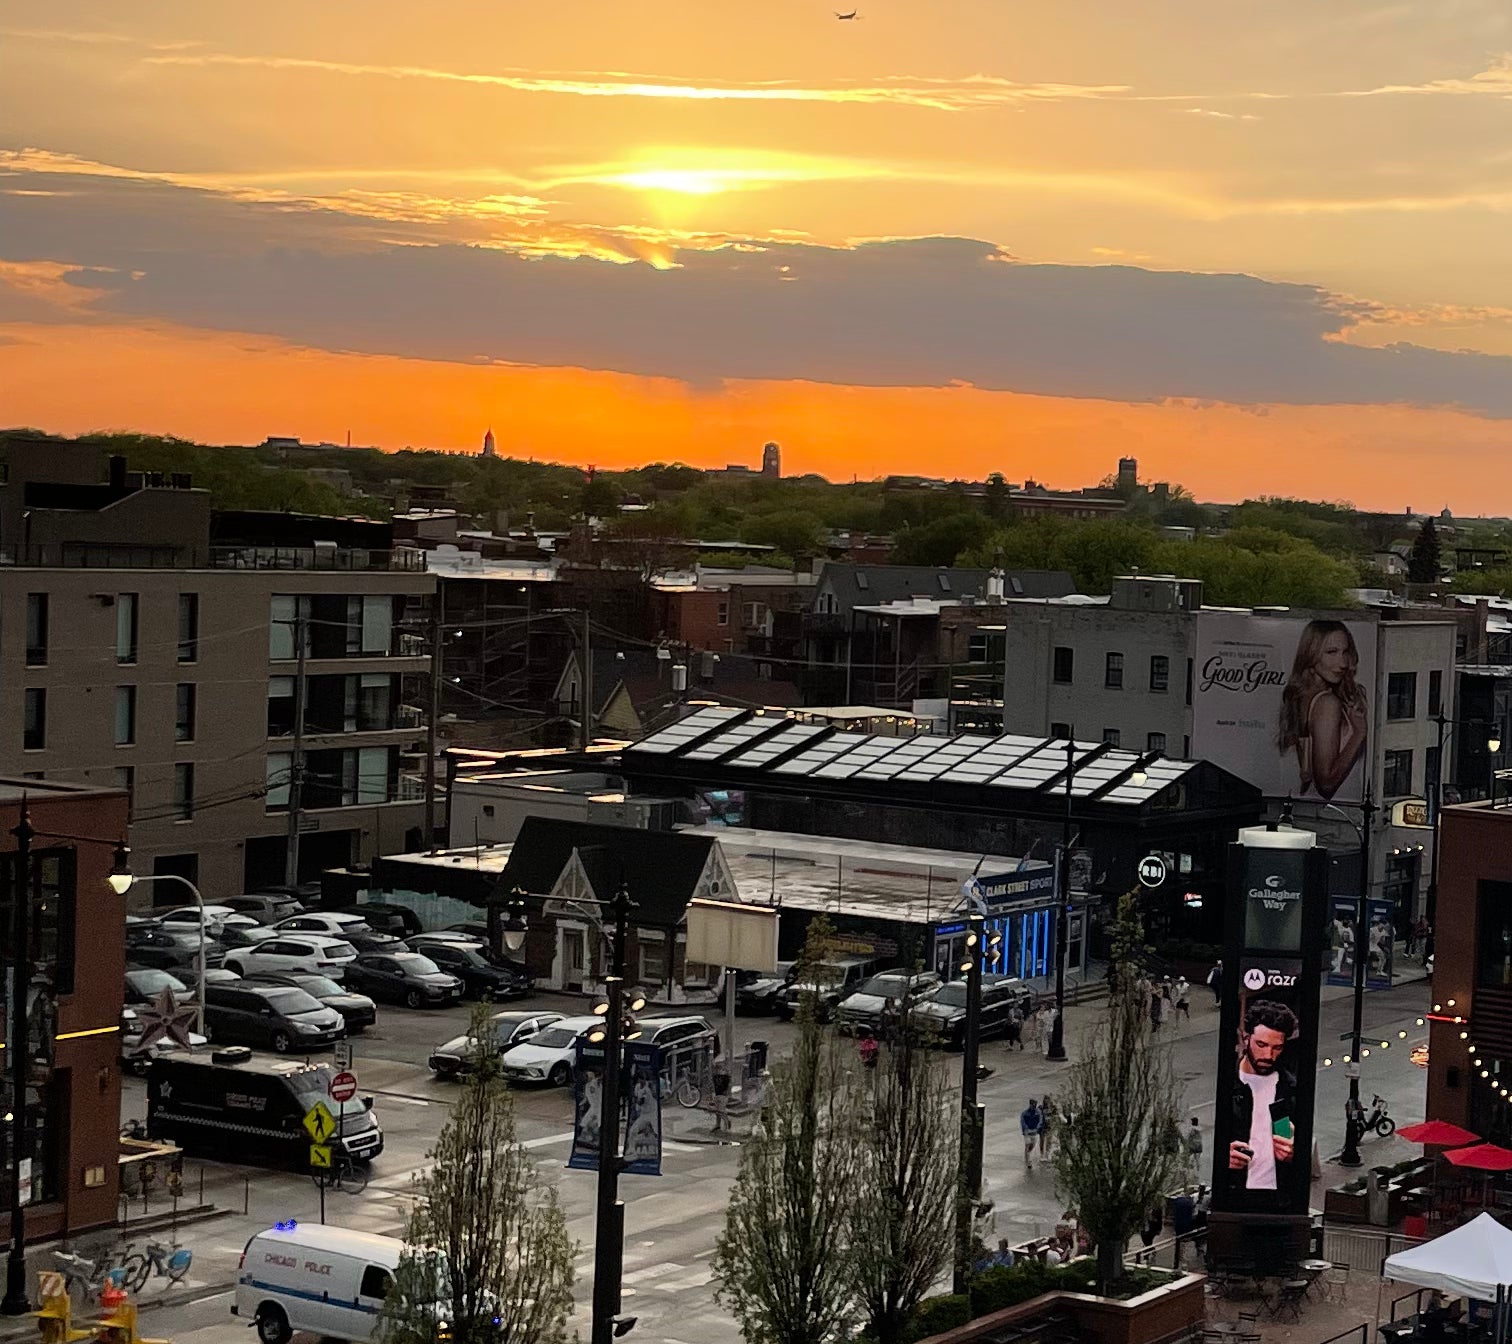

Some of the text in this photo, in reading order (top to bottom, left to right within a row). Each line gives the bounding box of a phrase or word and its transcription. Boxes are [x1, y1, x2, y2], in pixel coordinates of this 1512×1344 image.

[1200, 656, 1286, 693] GOOD GIRL
[1249, 889, 1300, 901] Gallagher
[1263, 900, 1286, 911] Way
[1267, 974, 1297, 986] razr
[305, 1261, 333, 1275] POLICE
